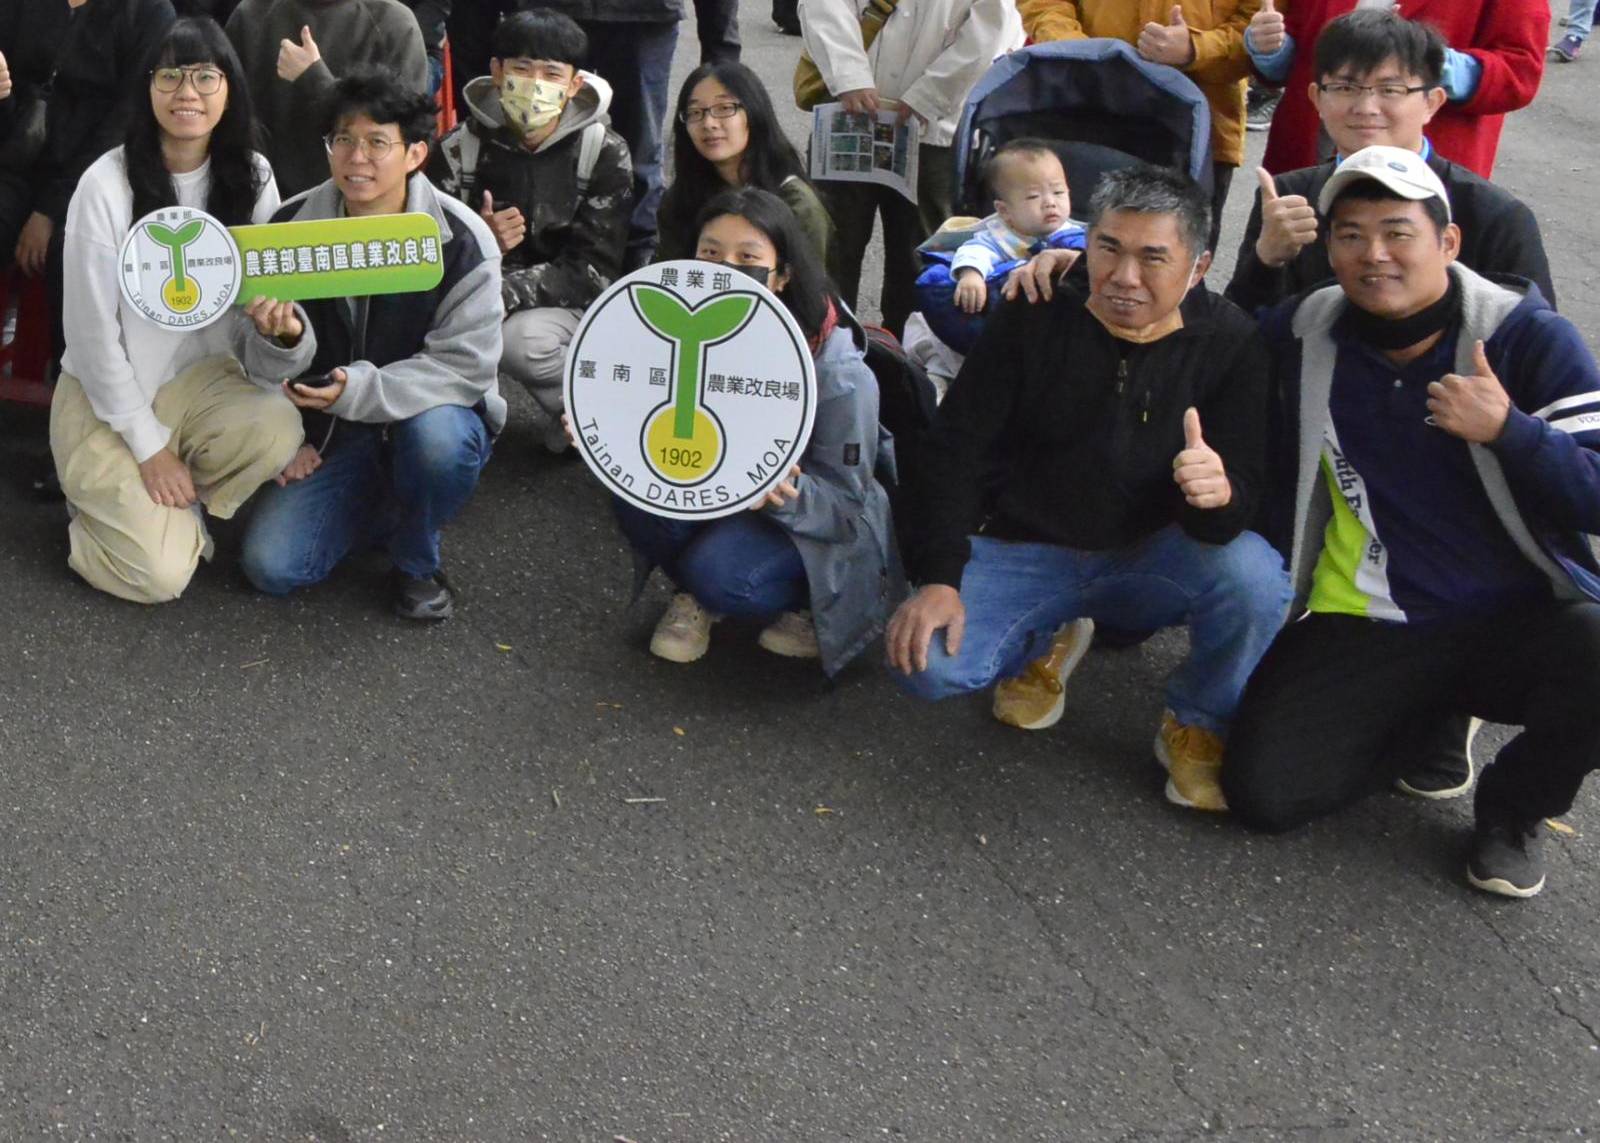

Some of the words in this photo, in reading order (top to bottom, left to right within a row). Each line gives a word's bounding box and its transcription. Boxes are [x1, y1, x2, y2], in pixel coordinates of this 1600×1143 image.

[156, 211, 193, 222] 農業部
[187, 255, 233, 269] 農業改良場
[245, 236, 440, 278] 農業部臺南區農業改良場
[659, 267, 733, 292] 農業部
[132, 290, 164, 321] Tainan
[214, 282, 232, 309] MOA
[170, 295, 193, 307] 1902
[578, 359, 668, 387] 臺南區
[706, 374, 801, 402] 農業改良場
[581, 417, 636, 489] Tainan
[645, 482, 742, 508] DARES,
[746, 437, 792, 486] MOA
[659, 447, 703, 469] 1902
